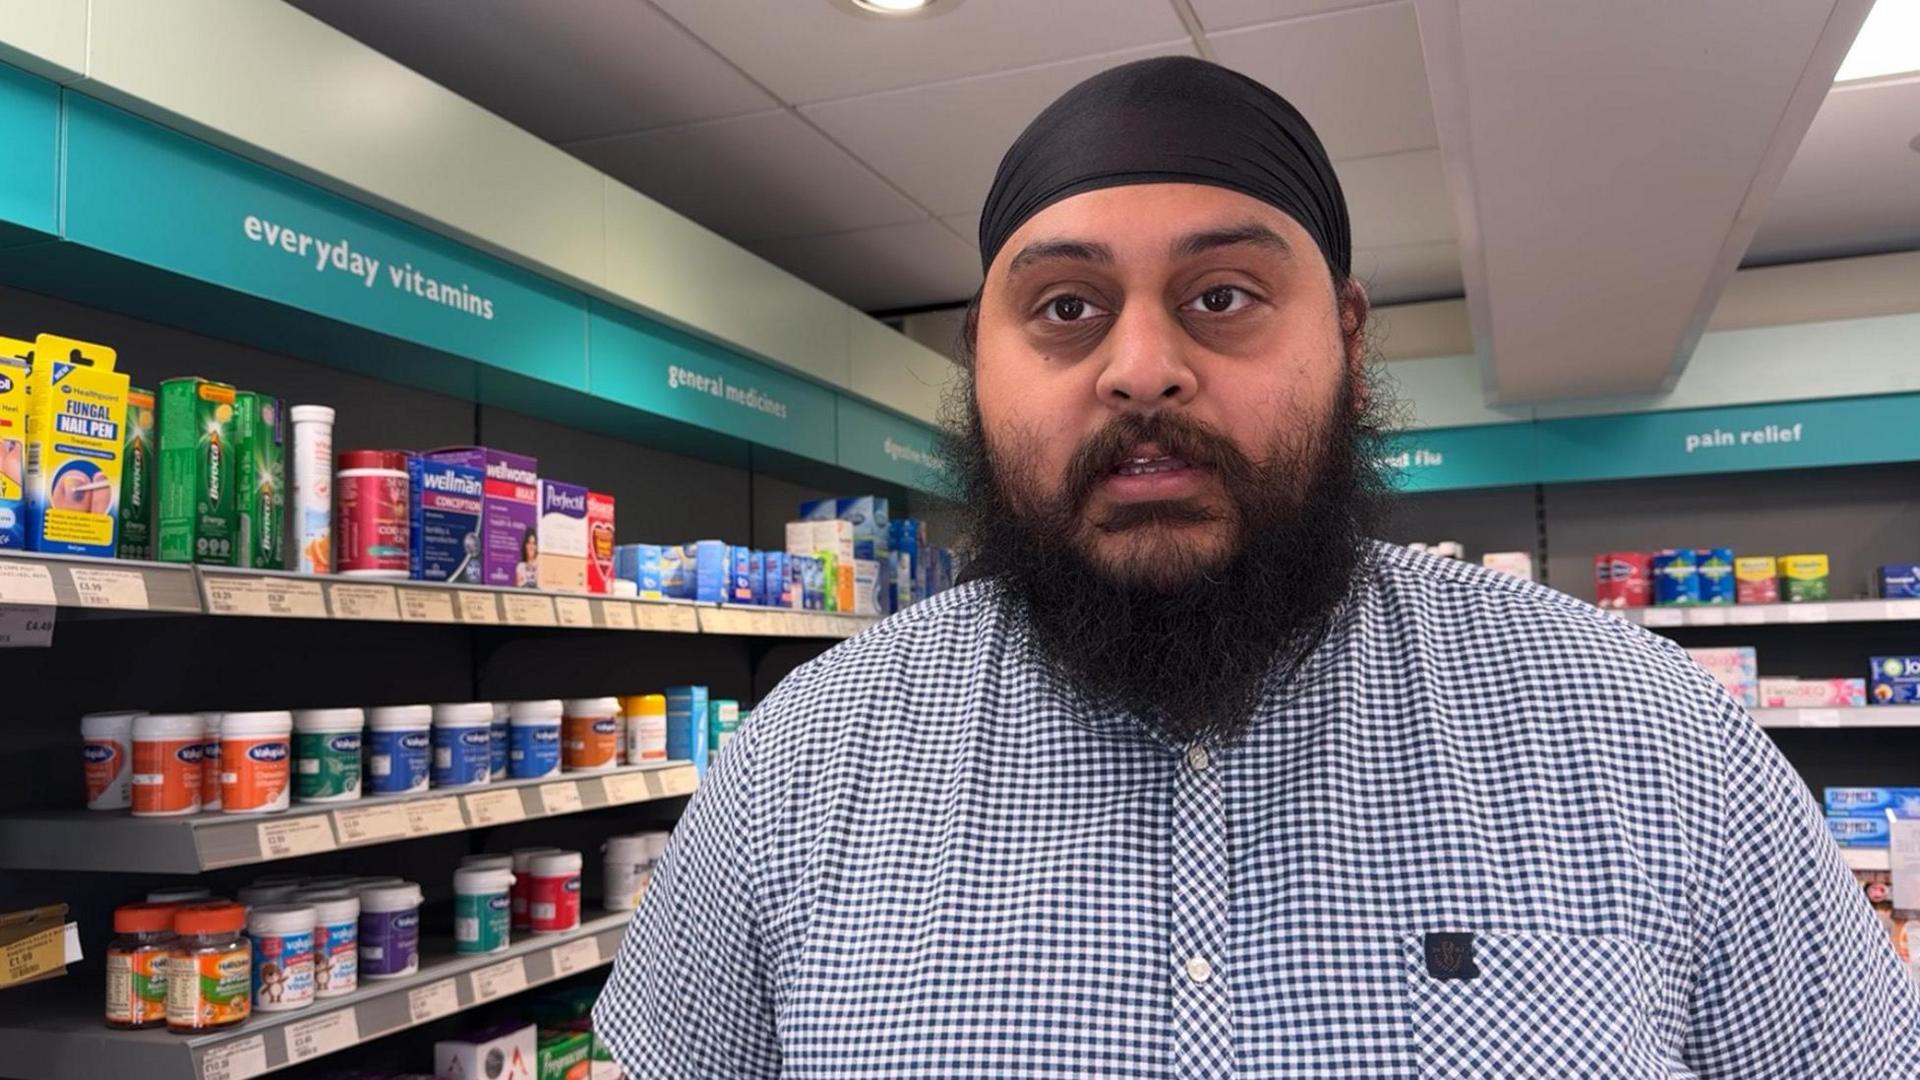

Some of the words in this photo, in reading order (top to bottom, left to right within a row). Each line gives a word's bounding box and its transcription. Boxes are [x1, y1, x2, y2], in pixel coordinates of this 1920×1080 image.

[244, 214, 380, 288] everyday
[389, 264, 494, 320] vitamins
[668, 364, 723, 398] general
[726, 384, 788, 419] medicines
[67, 399, 110, 420] FUNGAL
[61, 416, 88, 436] NAIL
[90, 421, 114, 439] PEN
[1685, 428, 1735, 453] pain
[1740, 422, 1803, 444] relief
[132, 449, 143, 507] Berocca
[209, 443, 220, 501] Berocca
[424, 470, 482, 496] wellman
[487, 461, 537, 486] wellwoman
[547, 484, 585, 511] Perfectil
[262, 493, 274, 551] Berocca
